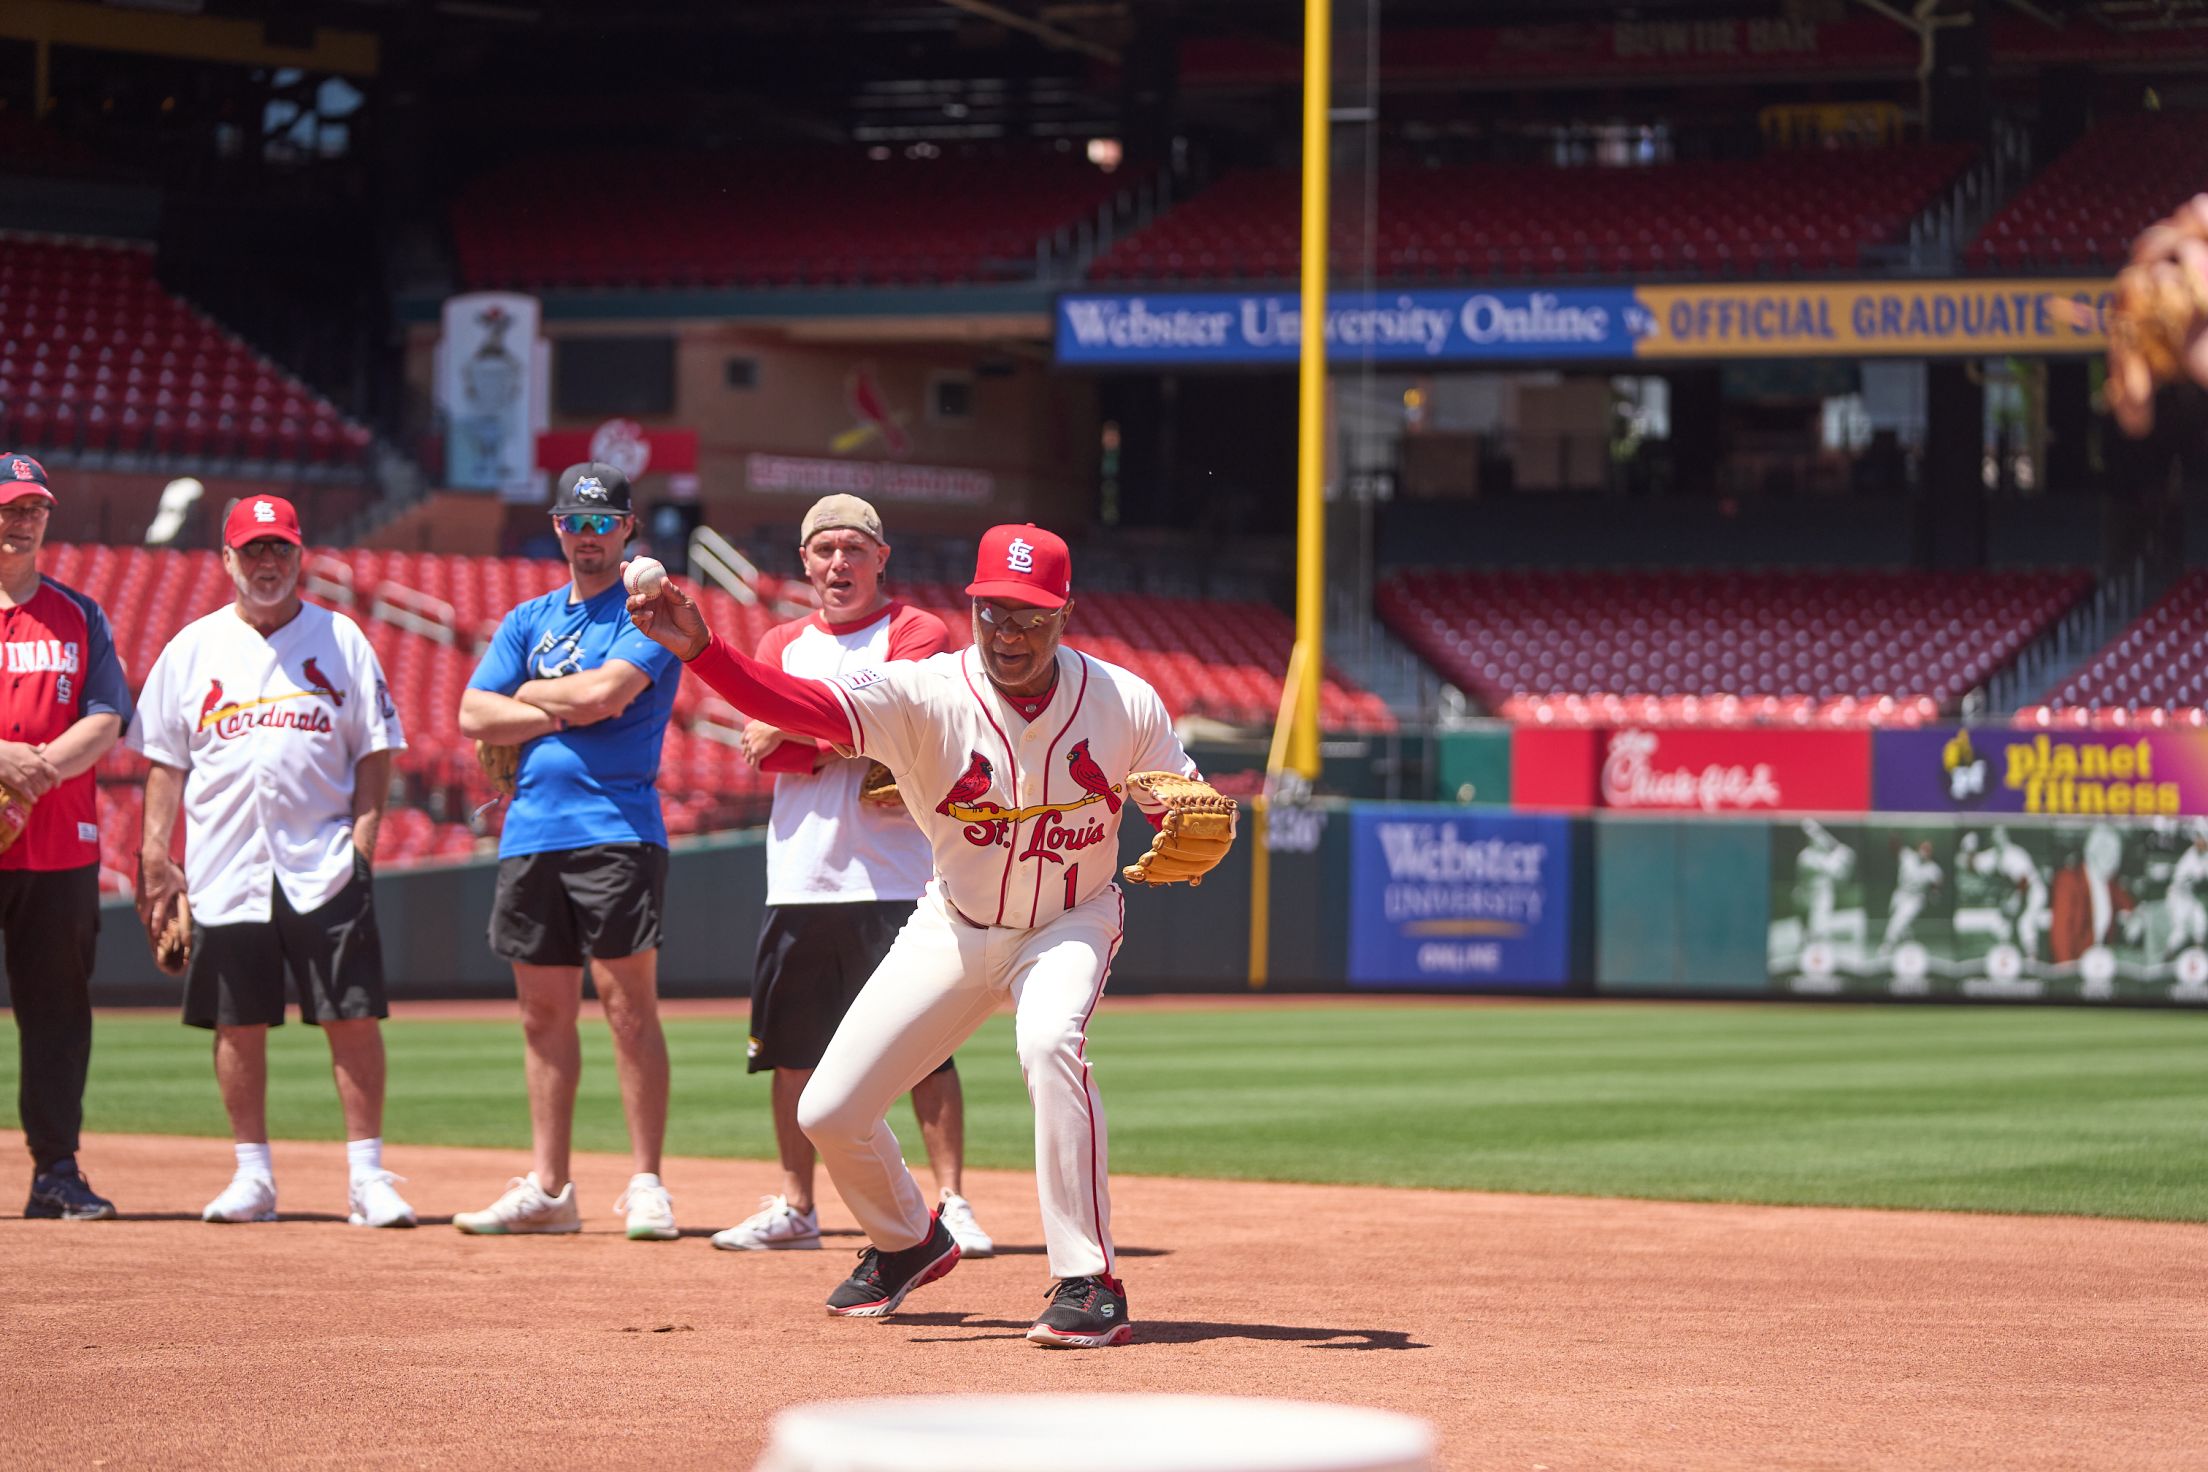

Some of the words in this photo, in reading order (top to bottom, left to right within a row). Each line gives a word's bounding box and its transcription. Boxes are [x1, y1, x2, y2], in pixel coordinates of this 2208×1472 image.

[1065, 299, 1233, 346] Webster
[1460, 292, 1609, 345] Online
[1669, 296, 1836, 341] OFFICIAL
[1852, 293, 2056, 338] GRADUATE
[0, 639, 79, 674] INALS
[215, 702, 332, 740] Cardinals
[2005, 735, 2152, 789] planet
[2025, 776, 2181, 815] fitness
[963, 801, 1011, 848] St.
[1019, 809, 1105, 865] Louis
[1377, 821, 1548, 882] Webster
[1064, 862, 1079, 910] 1
[1384, 883, 1547, 925] UNIVERSITY
